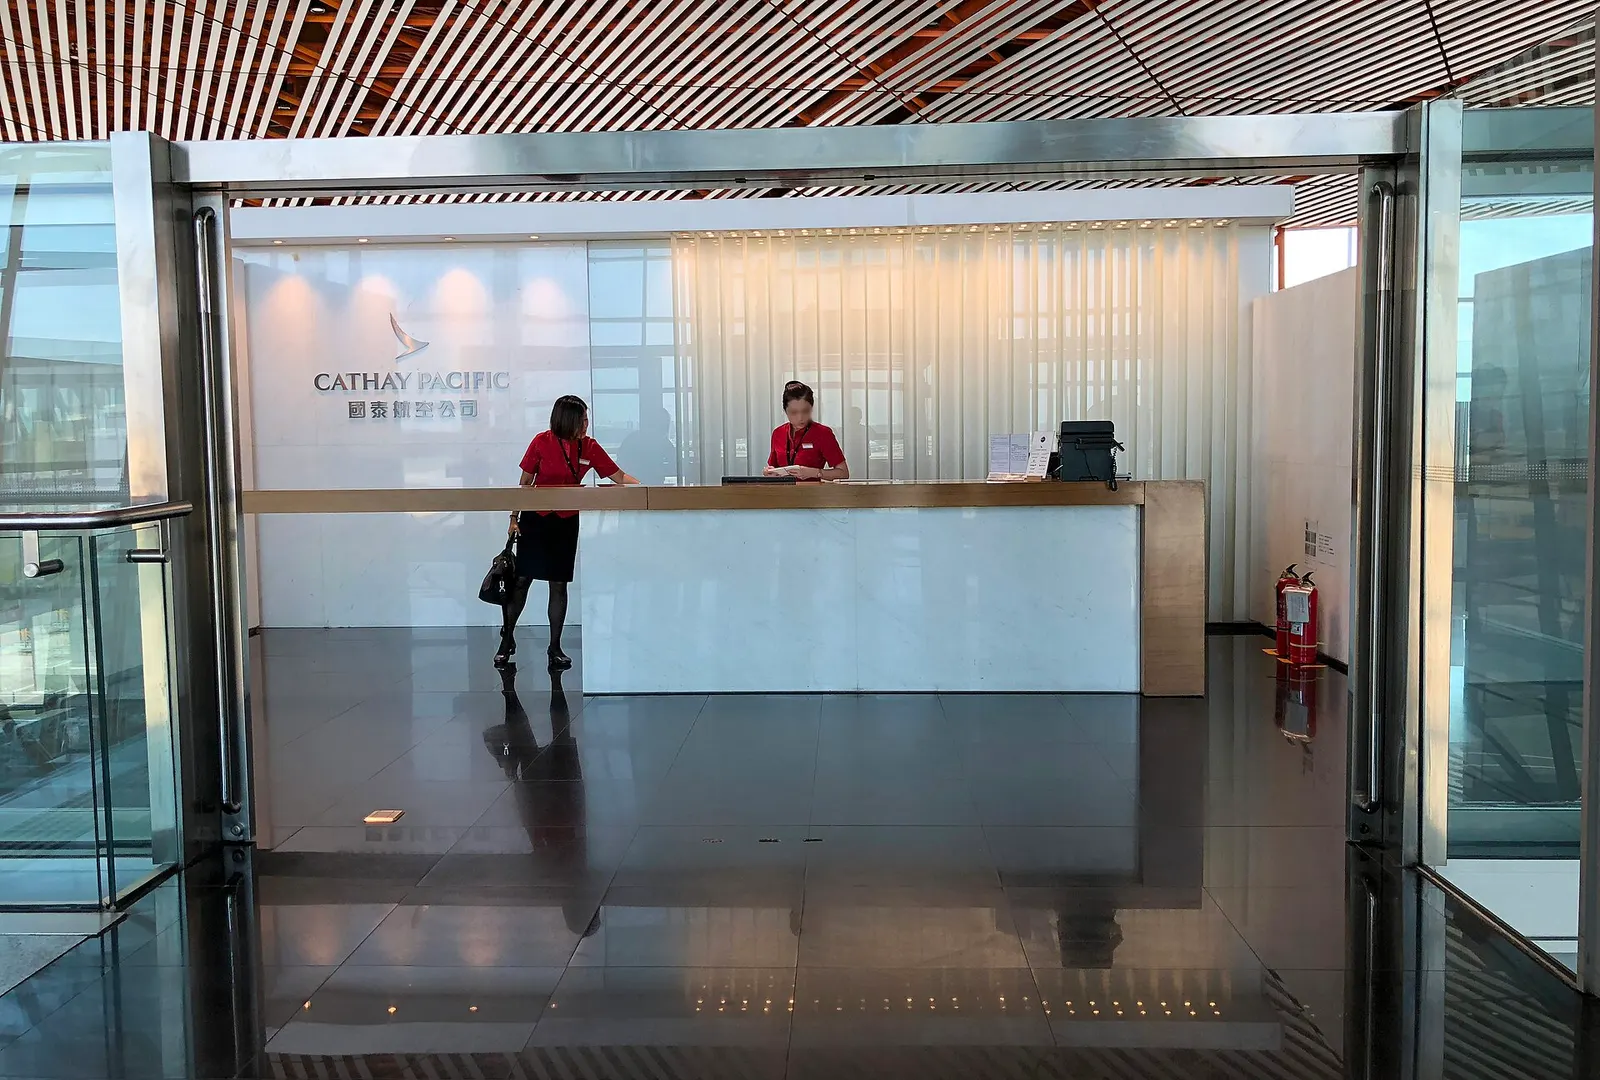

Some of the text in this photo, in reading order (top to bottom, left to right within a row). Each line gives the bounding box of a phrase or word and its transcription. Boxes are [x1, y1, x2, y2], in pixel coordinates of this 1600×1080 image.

[313, 371, 510, 391] CATHAY PACIFIC
[348, 399, 478, 419] 國泰航空公司
